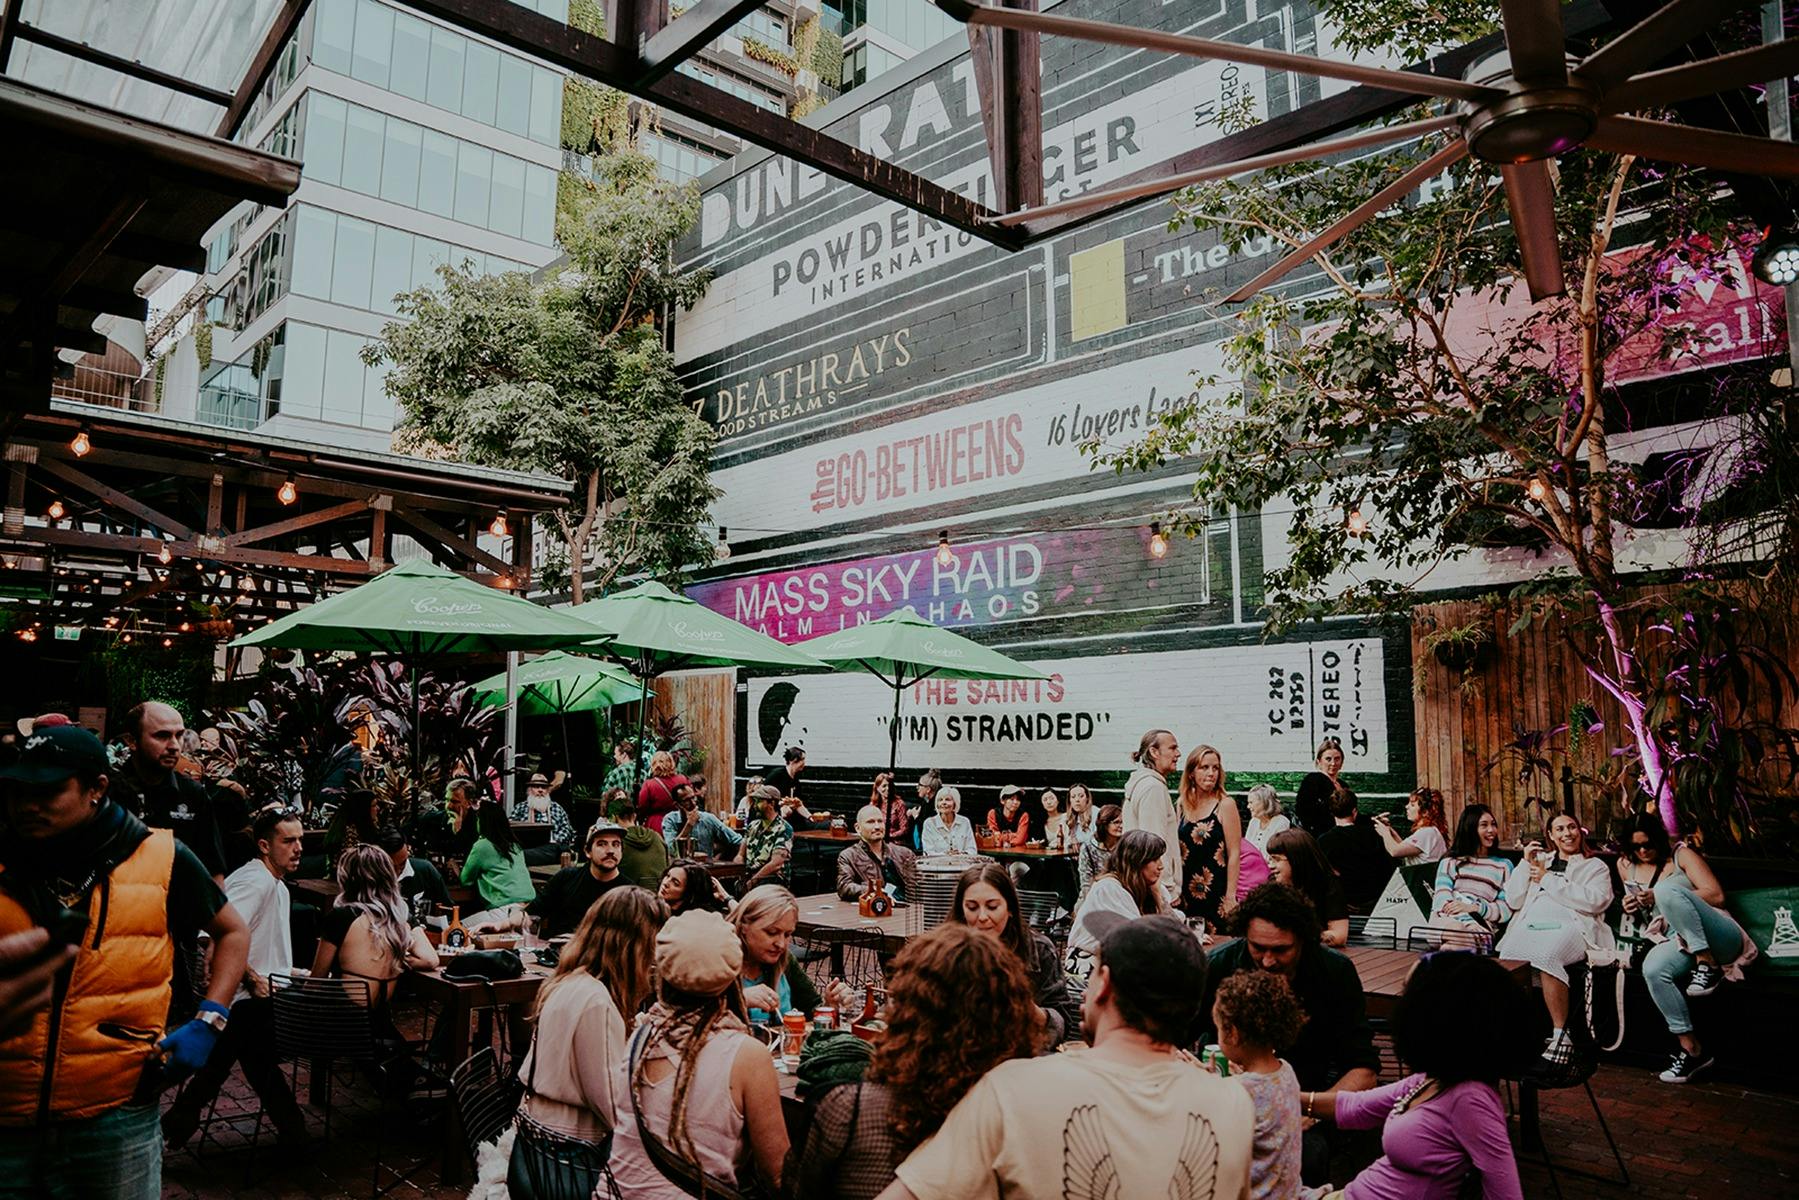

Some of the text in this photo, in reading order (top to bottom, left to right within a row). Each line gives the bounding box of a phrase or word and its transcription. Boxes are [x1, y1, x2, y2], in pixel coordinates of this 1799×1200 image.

[859, 57, 983, 161] RAT
[716, 328, 911, 424] DEATHRAYS
[712, 391, 837, 440] OODSTREAMS
[1047, 413, 1067, 446] 16
[1070, 403, 1141, 443] Lovers
[810, 413, 1025, 513] the GO-BETWEENS
[734, 543, 1043, 623] MASS SKY RAID
[758, 616, 813, 638] ALM
[913, 673, 1065, 705] THE SAINTS
